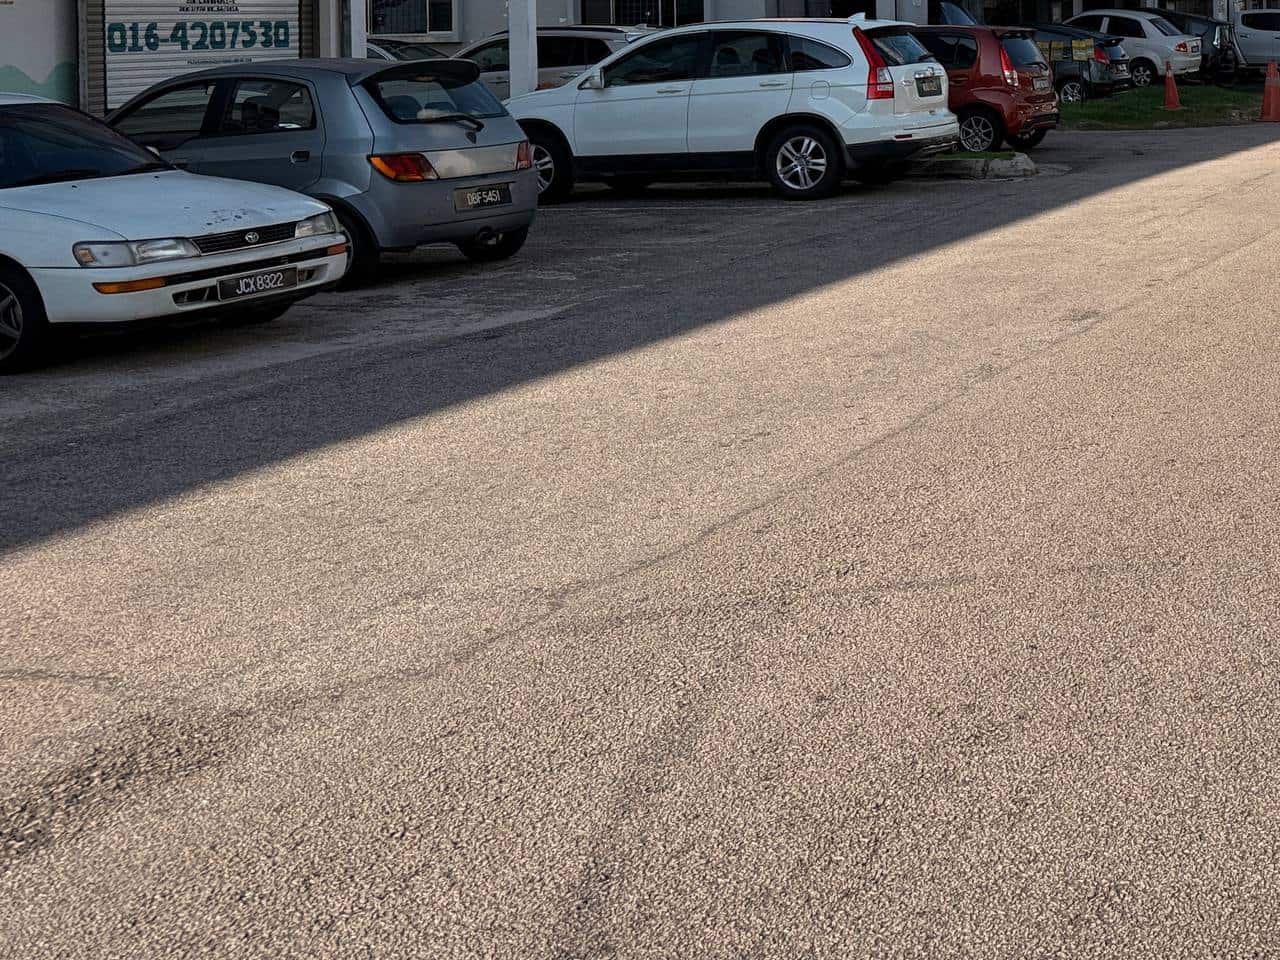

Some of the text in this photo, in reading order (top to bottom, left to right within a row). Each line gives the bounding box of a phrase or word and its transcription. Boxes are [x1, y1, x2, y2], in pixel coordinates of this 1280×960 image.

[107, 20, 290, 53] 016-4207530
[236, 272, 284, 295] JCX 8322
